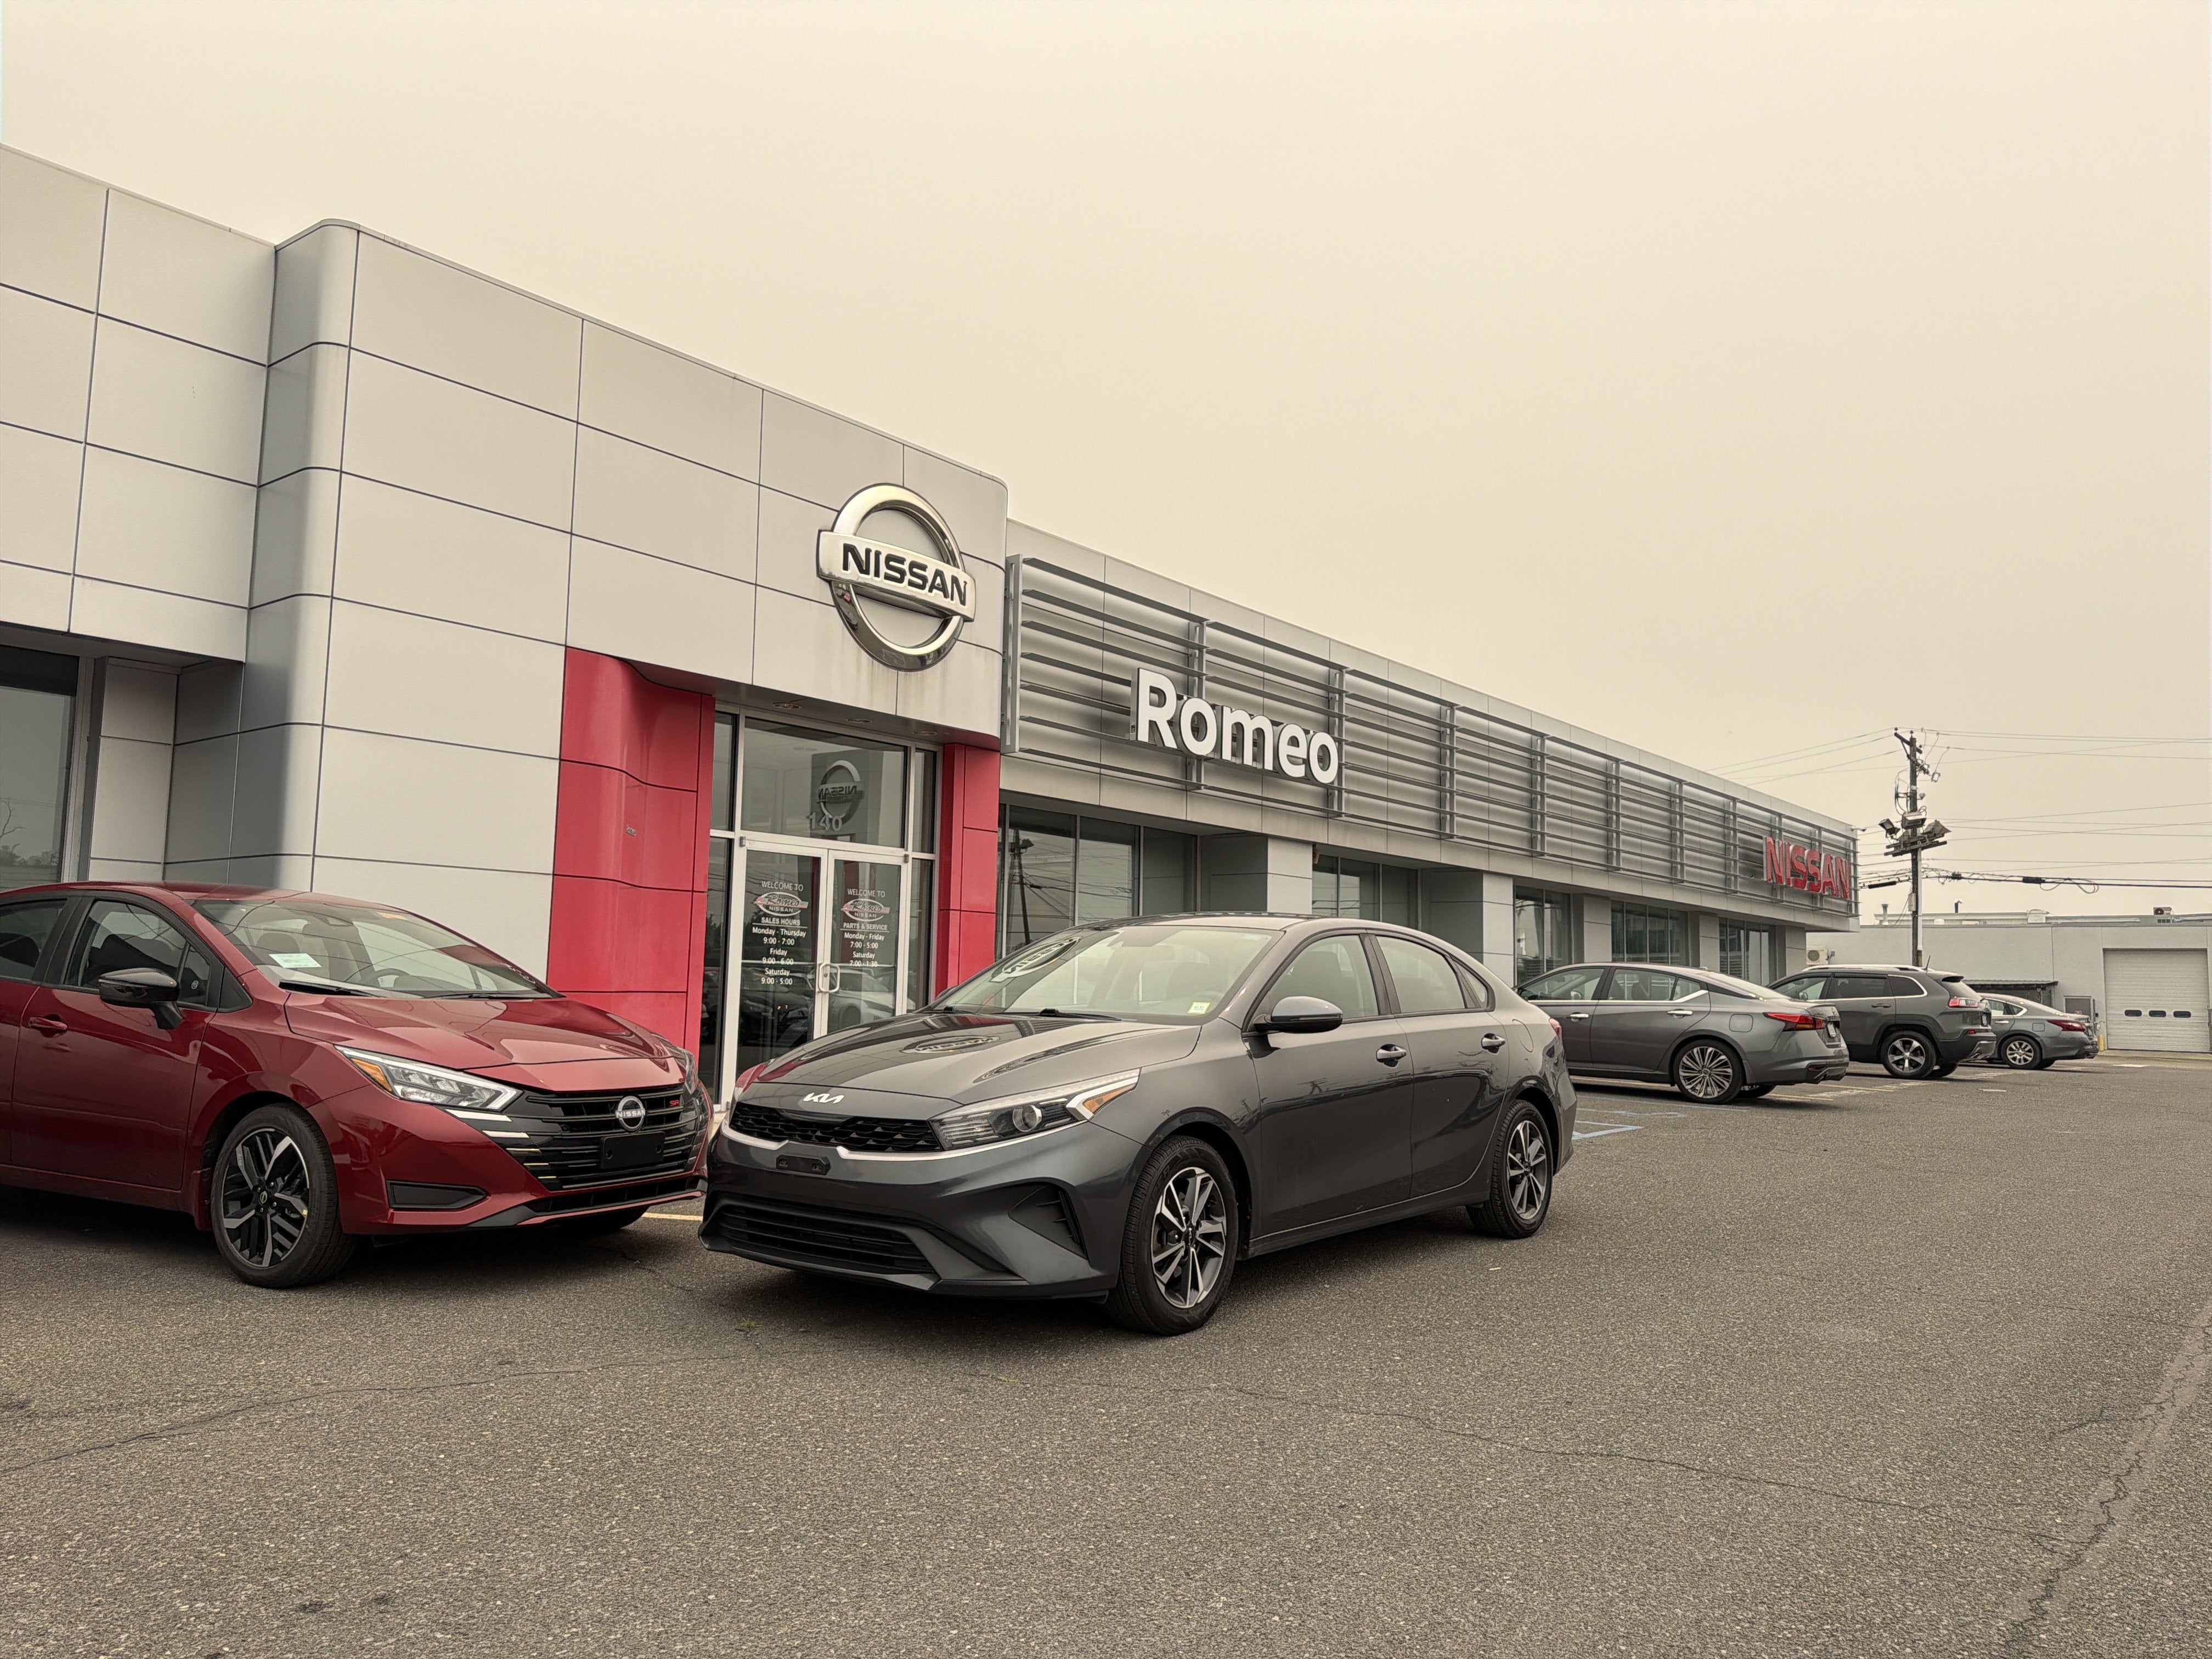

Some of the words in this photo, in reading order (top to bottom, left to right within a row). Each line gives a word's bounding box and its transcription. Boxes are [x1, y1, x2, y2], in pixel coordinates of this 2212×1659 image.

[843, 543, 967, 606] NISSAN
[1136, 667, 1339, 784] Romeo
[809, 812, 842, 831] 140
[1765, 836, 1850, 901] NISSAN
[761, 881, 793, 890] WELCOME
[794, 883, 804, 891] TO
[847, 888, 876, 897] WELCOME
[765, 894, 800, 906] Romeo
[853, 900, 882, 912] Romeo
[752, 927, 776, 936] Monday
[780, 929, 806, 938] Thursday
[844, 932, 865, 940] Monday
[770, 947, 788, 957] Friday
[853, 951, 876, 960] Saturday
[765, 968, 790, 977] Saturday
[803, 1092, 845, 1104] KIA
[616, 1109, 645, 1119] NISSAN
